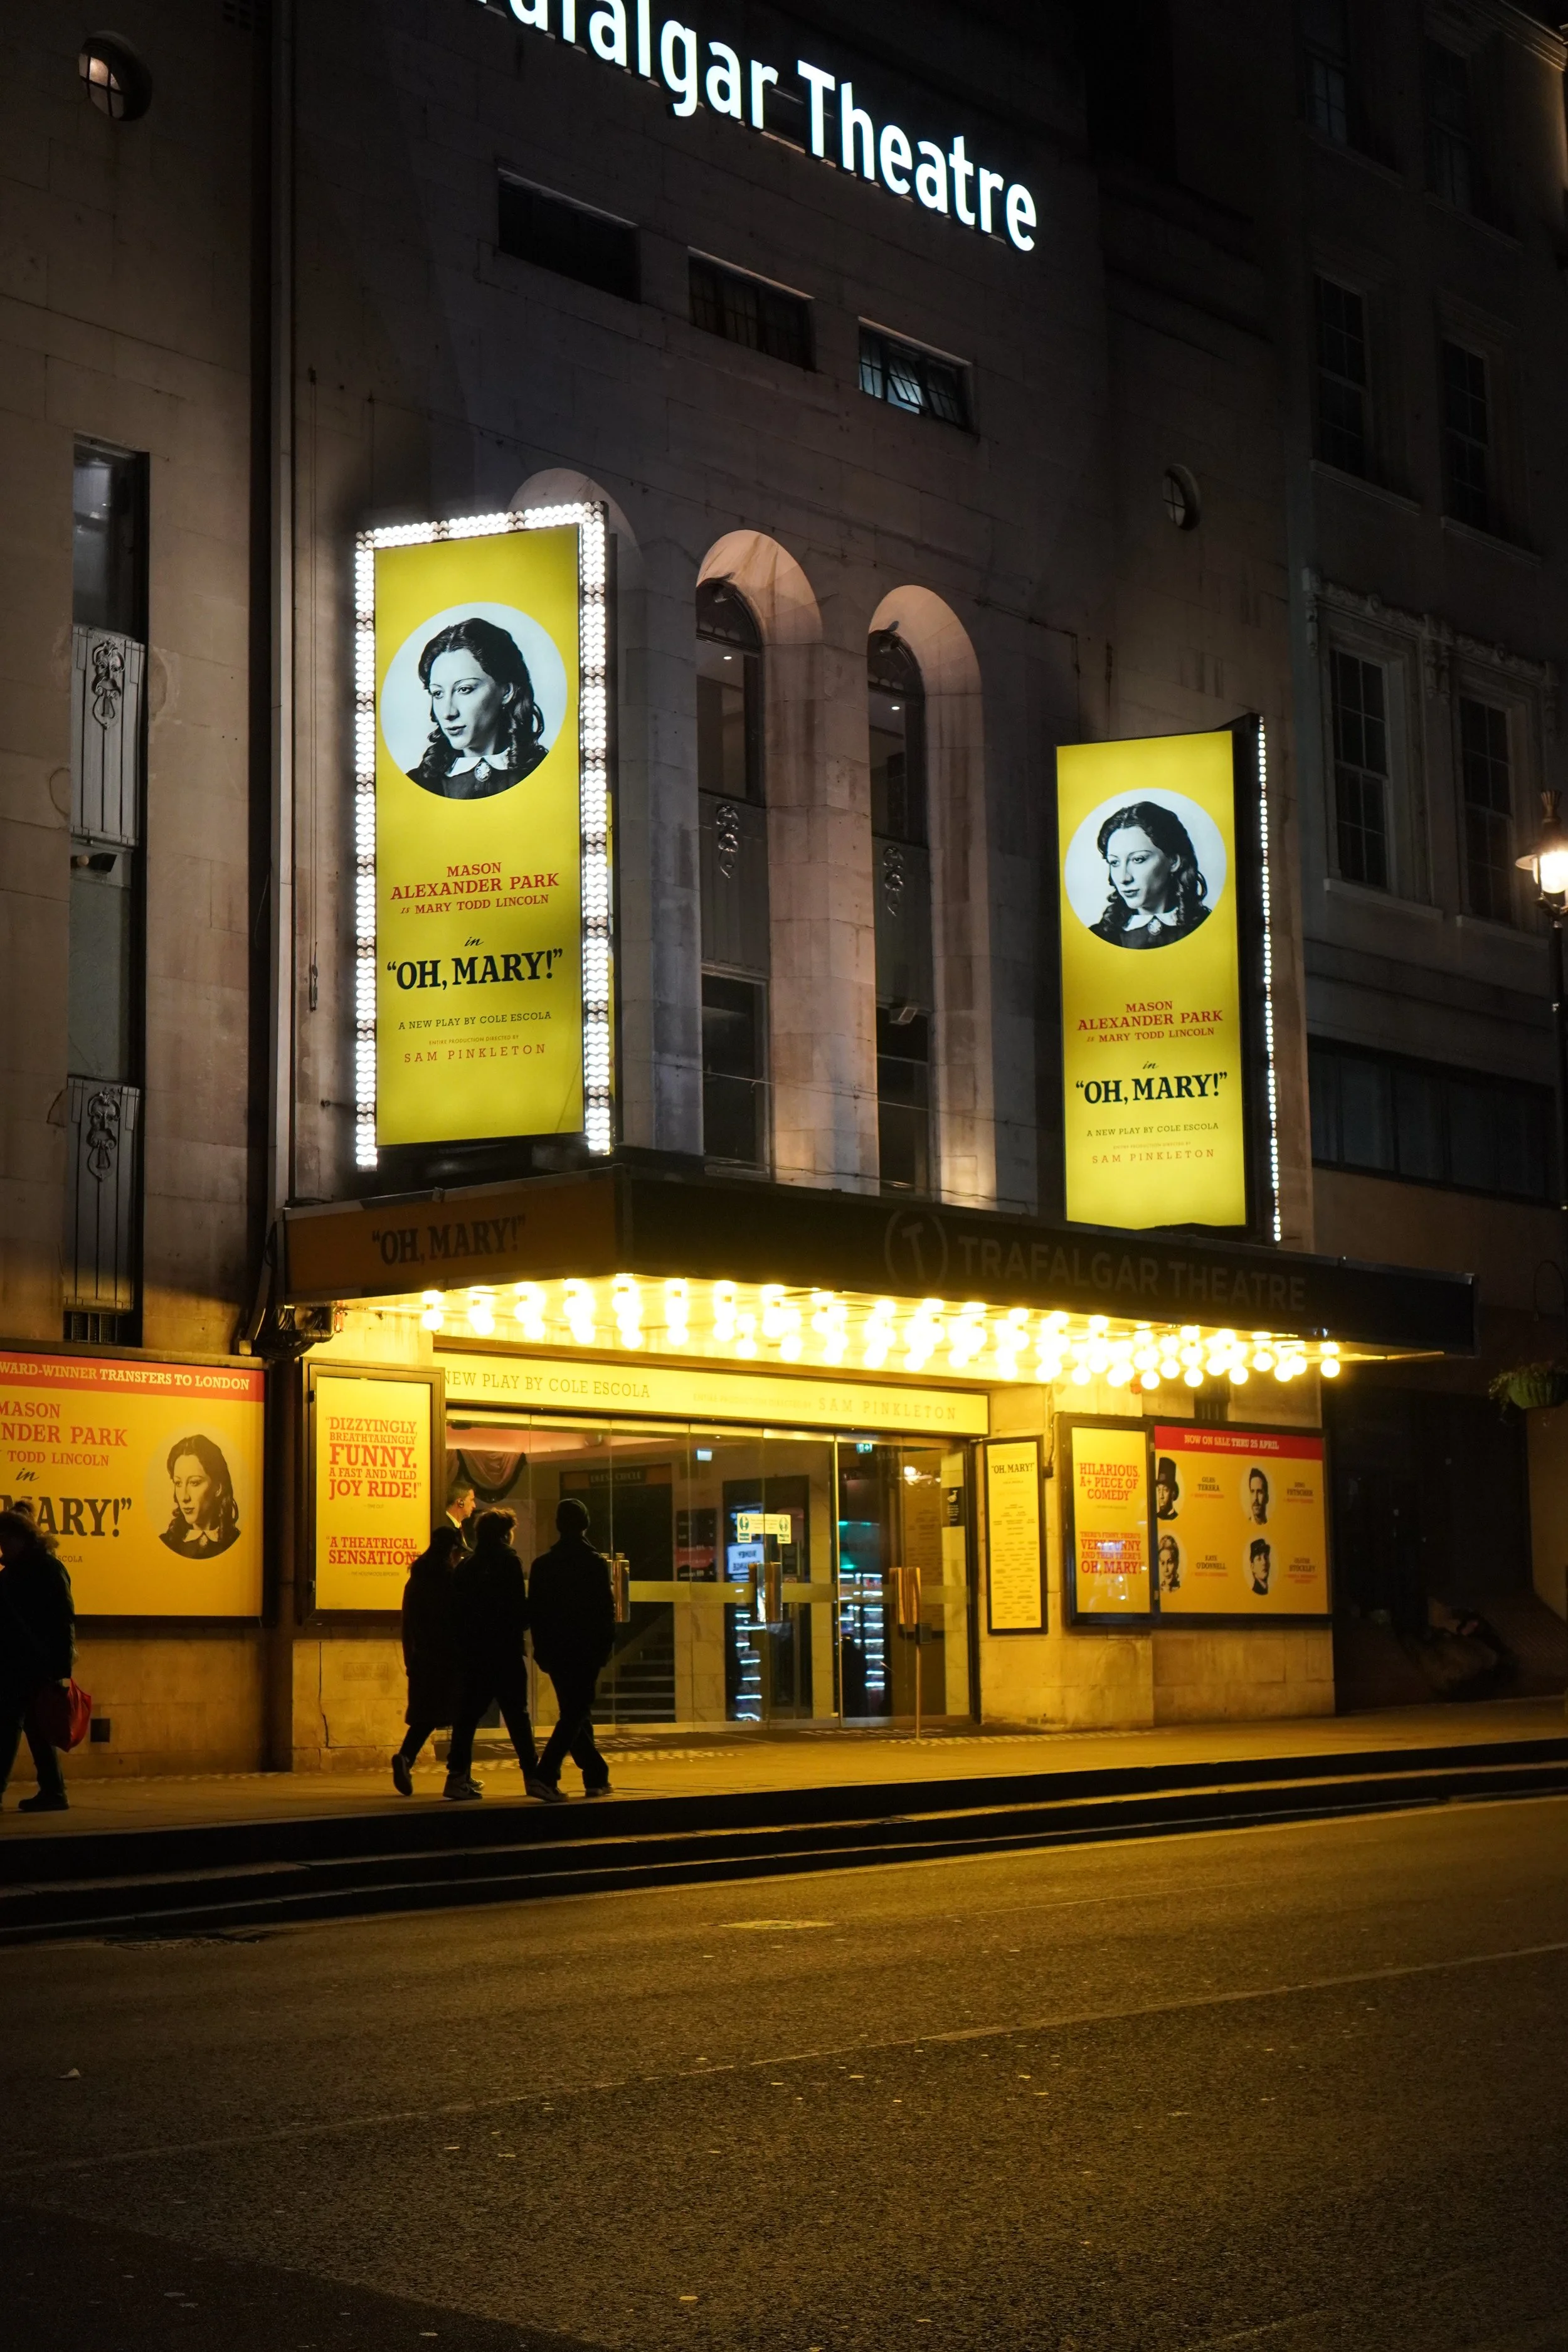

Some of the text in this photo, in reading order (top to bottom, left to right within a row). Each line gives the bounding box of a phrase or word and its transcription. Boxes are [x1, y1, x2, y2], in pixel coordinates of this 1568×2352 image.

[797, 60, 1037, 252] Theatre
[447, 862, 502, 877] MASON
[390, 872, 559, 899] ALEXANDER PARK
[415, 902, 452, 914] MARY
[457, 899, 490, 911] TODD
[495, 894, 549, 907] LINCOLN
[464, 936, 484, 946] in
[387, 948, 563, 990] “OH, MARY!”
[1126, 1000, 1173, 1013] MASON
[398, 1011, 552, 1030] A NEW PLAY BY COLE ESCOLA
[1077, 1010, 1223, 1030] ALEXANDER PARK
[1099, 1032, 1131, 1042] MARY
[1135, 1030, 1165, 1040] TODD
[1168, 1027, 1214, 1037] LINCOLN
[405, 1044, 545, 1062] SAM PINKLETON
[1142, 1061, 1158, 1069] in
[1076, 1071, 1227, 1105] “OH, MARY!”
[1093, 1149, 1214, 1163] SAM PINKLETON
[371, 1214, 526, 1266] “OH, MARY!”
[958, 1235, 1160, 1296] TRAFALGAR
[1167, 1260, 1306, 1312] THEATRE
[100, 1369, 171, 1385] TRANSFERS
[174, 1374, 192, 1385] TO
[195, 1375, 250, 1390] LONDON
[482, 1373, 519, 1389] PLAY
[526, 1376, 543, 1391] BY
[549, 1378, 588, 1394] COLE
[593, 1381, 650, 1398] ESCOLA
[0, 1401, 61, 1419] MASON
[818, 1397, 852, 1412] SAM
[863, 1399, 956, 1421] PINKLETON
[70, 1424, 128, 1447] PARK
[329, 1432, 416, 1445] BREATHTAKINGLY
[1184, 1434, 1201, 1445] NOW
[1202, 1435, 1213, 1445] ON
[1214, 1436, 1231, 1447] SALE
[1231, 1438, 1249, 1448] THRU
[1259, 1440, 1279, 1450] APRIL
[8, 1450, 110, 1466] TODD LINCOLN
[329, 1443, 416, 1468] FUNNY.
[16, 1468, 40, 1481] in
[329, 1467, 416, 1480] A FAST AND WILD
[1080, 1476, 1138, 1489] A+ PIECE OF
[329, 1479, 421, 1500] JOY RIDE!”
[1197, 1483, 1220, 1491] TERERA
[0, 1495, 132, 1537] ARY!”
[341, 1536, 417, 1549] THEATRICAL
[1081, 1560, 1102, 1576] OH,
